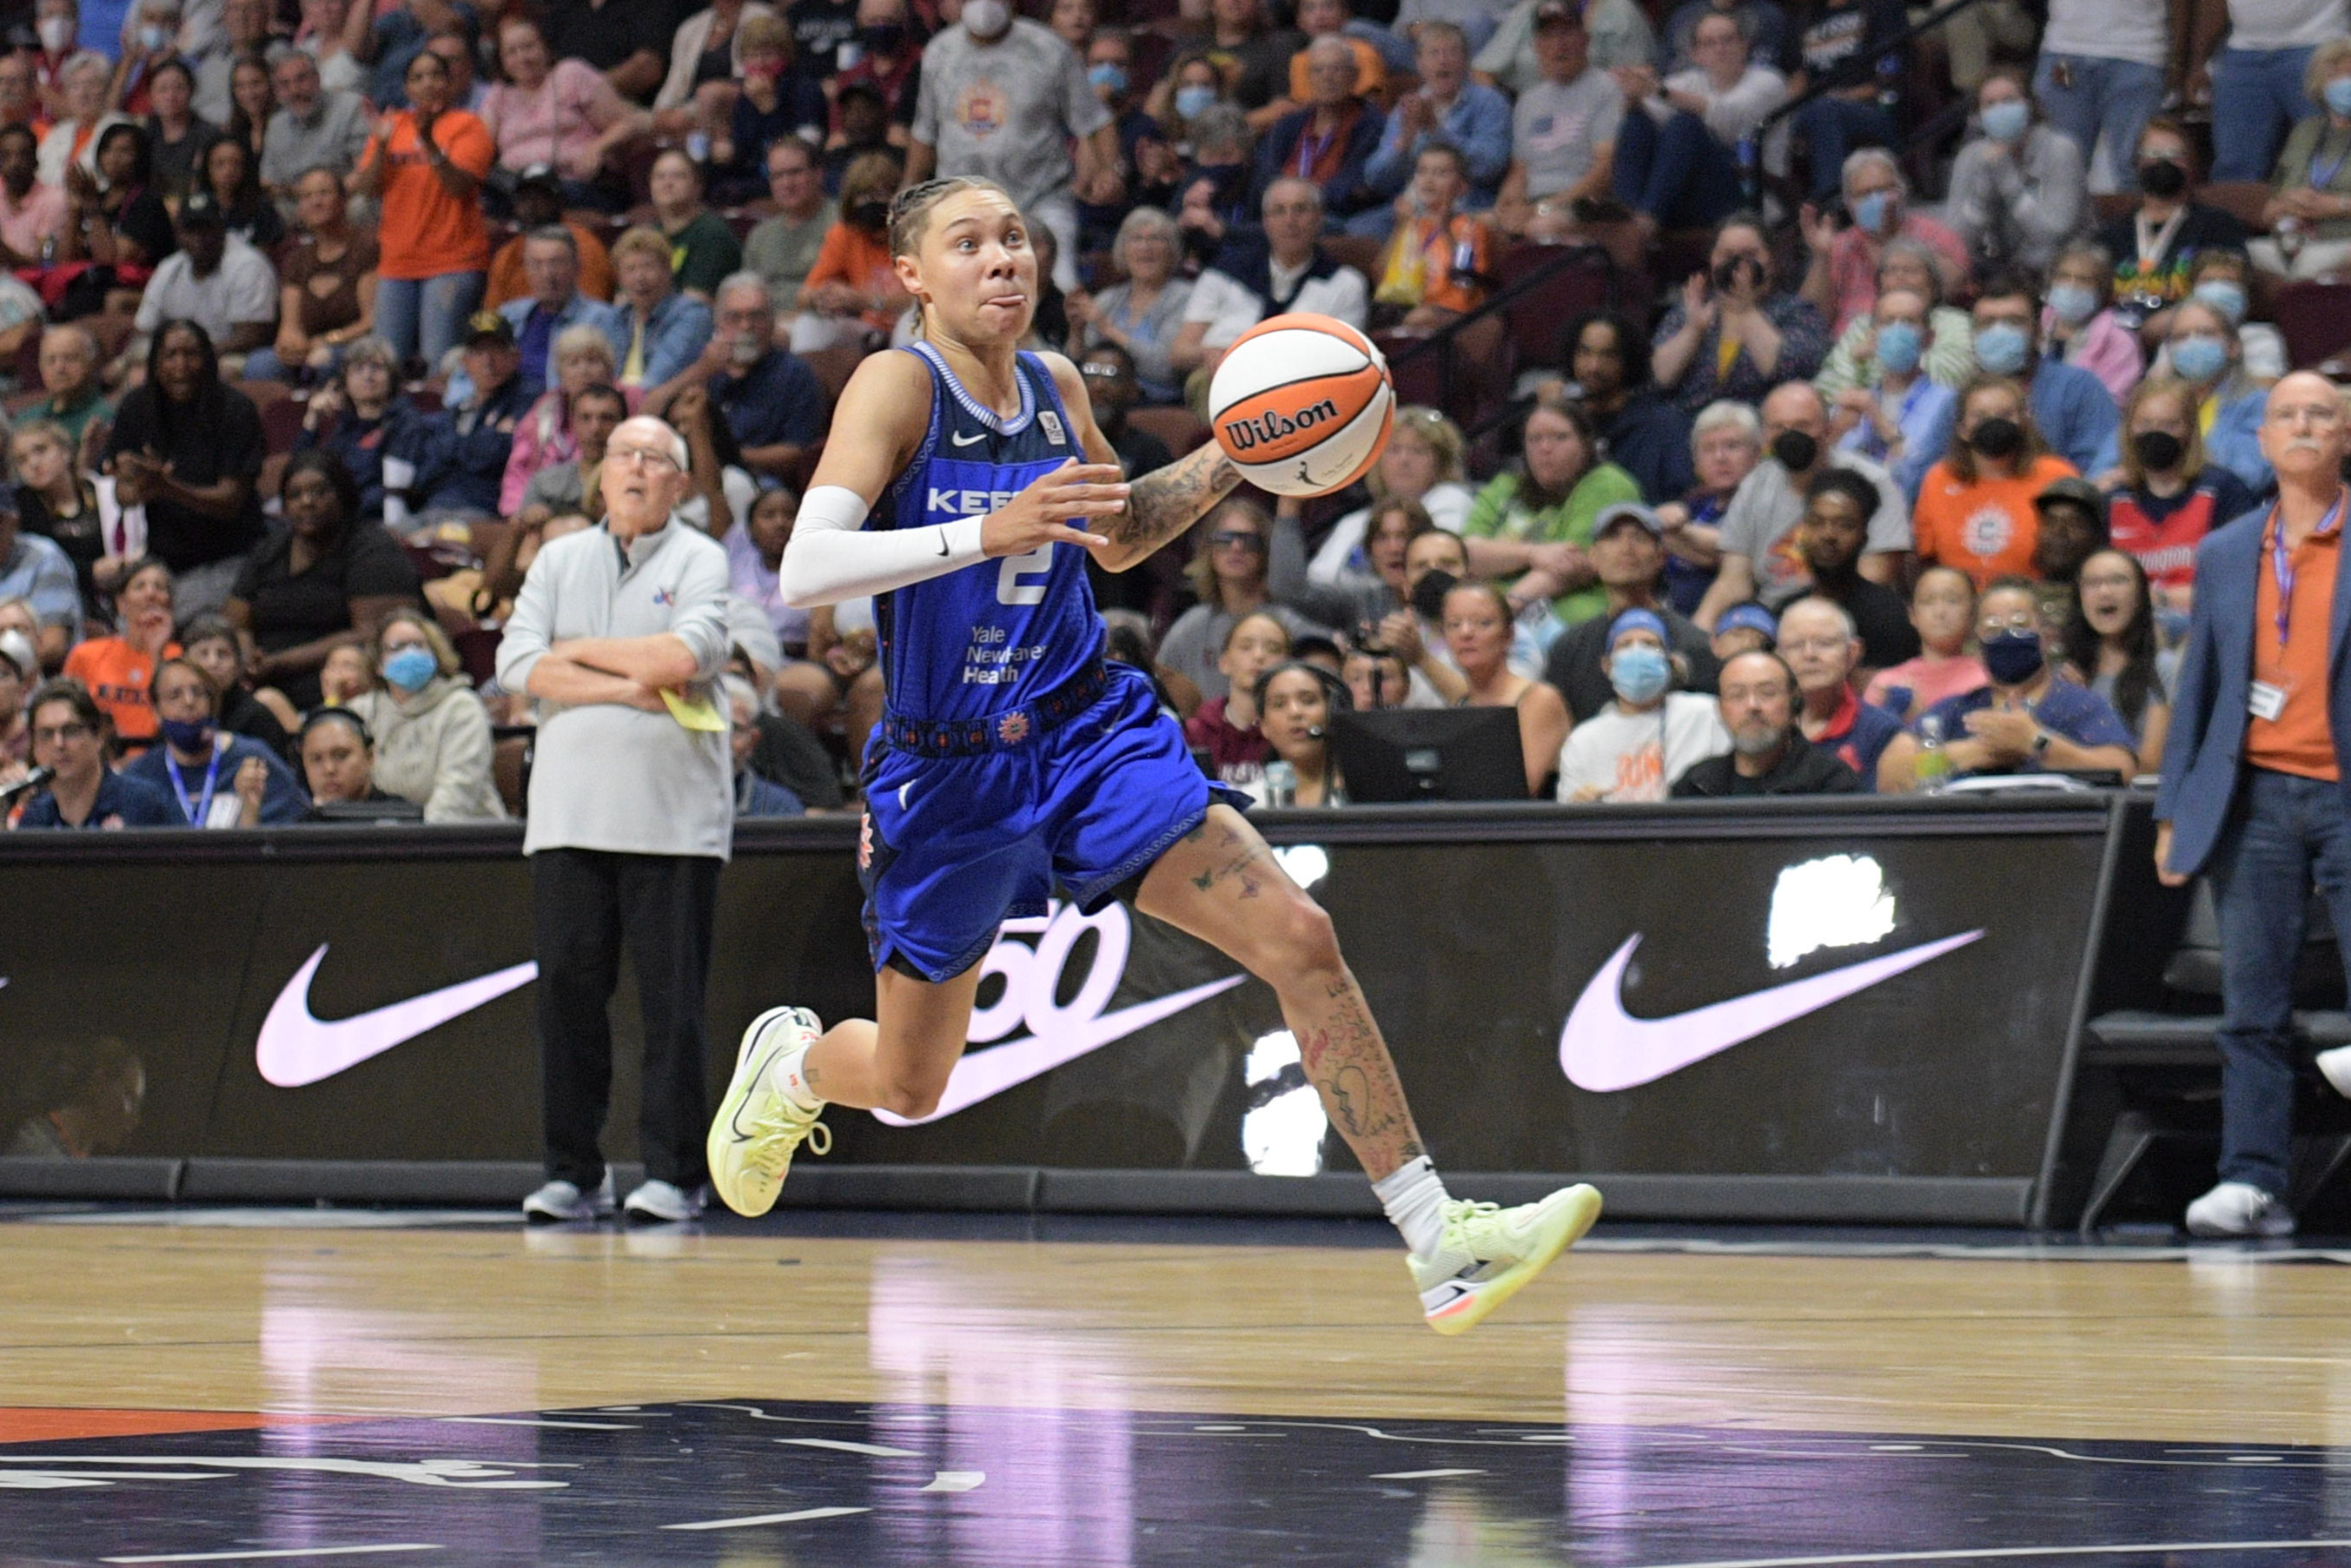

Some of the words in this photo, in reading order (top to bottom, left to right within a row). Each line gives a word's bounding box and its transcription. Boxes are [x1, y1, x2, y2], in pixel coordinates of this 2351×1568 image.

[1225, 400, 1339, 450] Wilson
[927, 487, 1023, 514] KEE
[997, 542, 1054, 605] 2
[971, 625, 1005, 643] Yale
[963, 665, 1018, 685] Health
[966, 898, 1130, 1041] 50
